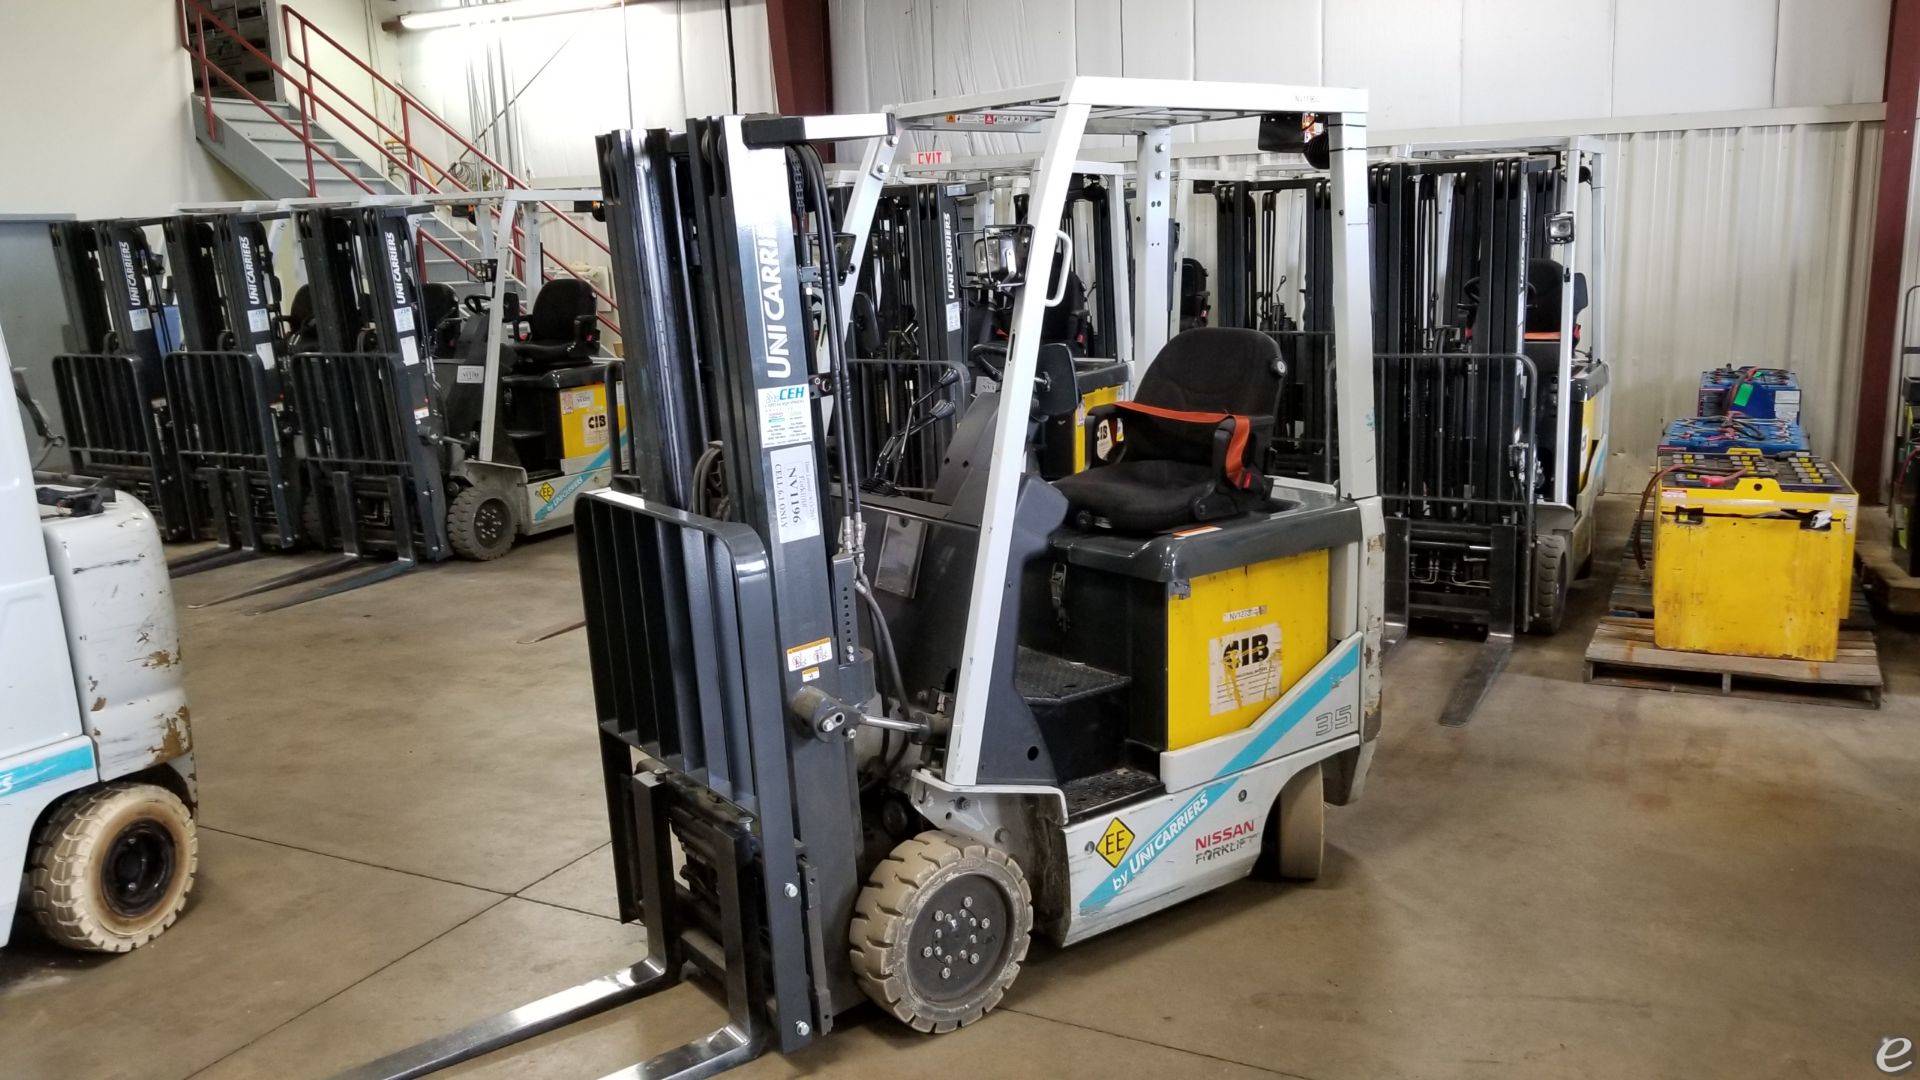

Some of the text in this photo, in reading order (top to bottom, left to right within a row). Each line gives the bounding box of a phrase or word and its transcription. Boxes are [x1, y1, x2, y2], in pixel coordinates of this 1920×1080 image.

[119, 241, 140, 306] UNICARRIERS
[239, 235, 260, 305] UNICARRIERS
[384, 231, 406, 304] UNICARRIERS
[943, 212, 955, 299] UNICARRIERS
[753, 225, 791, 378] UNICARRI
[588, 414, 606, 429] CIB
[779, 386, 804, 400] CEH
[787, 467, 801, 524] NV1196
[1223, 634, 1269, 670] CIB
[1316, 704, 1352, 736] 35
[1105, 829, 1126, 856] EE
[1112, 792, 1209, 890] by UNICARRIERS
[1195, 820, 1255, 851] NISSAN
